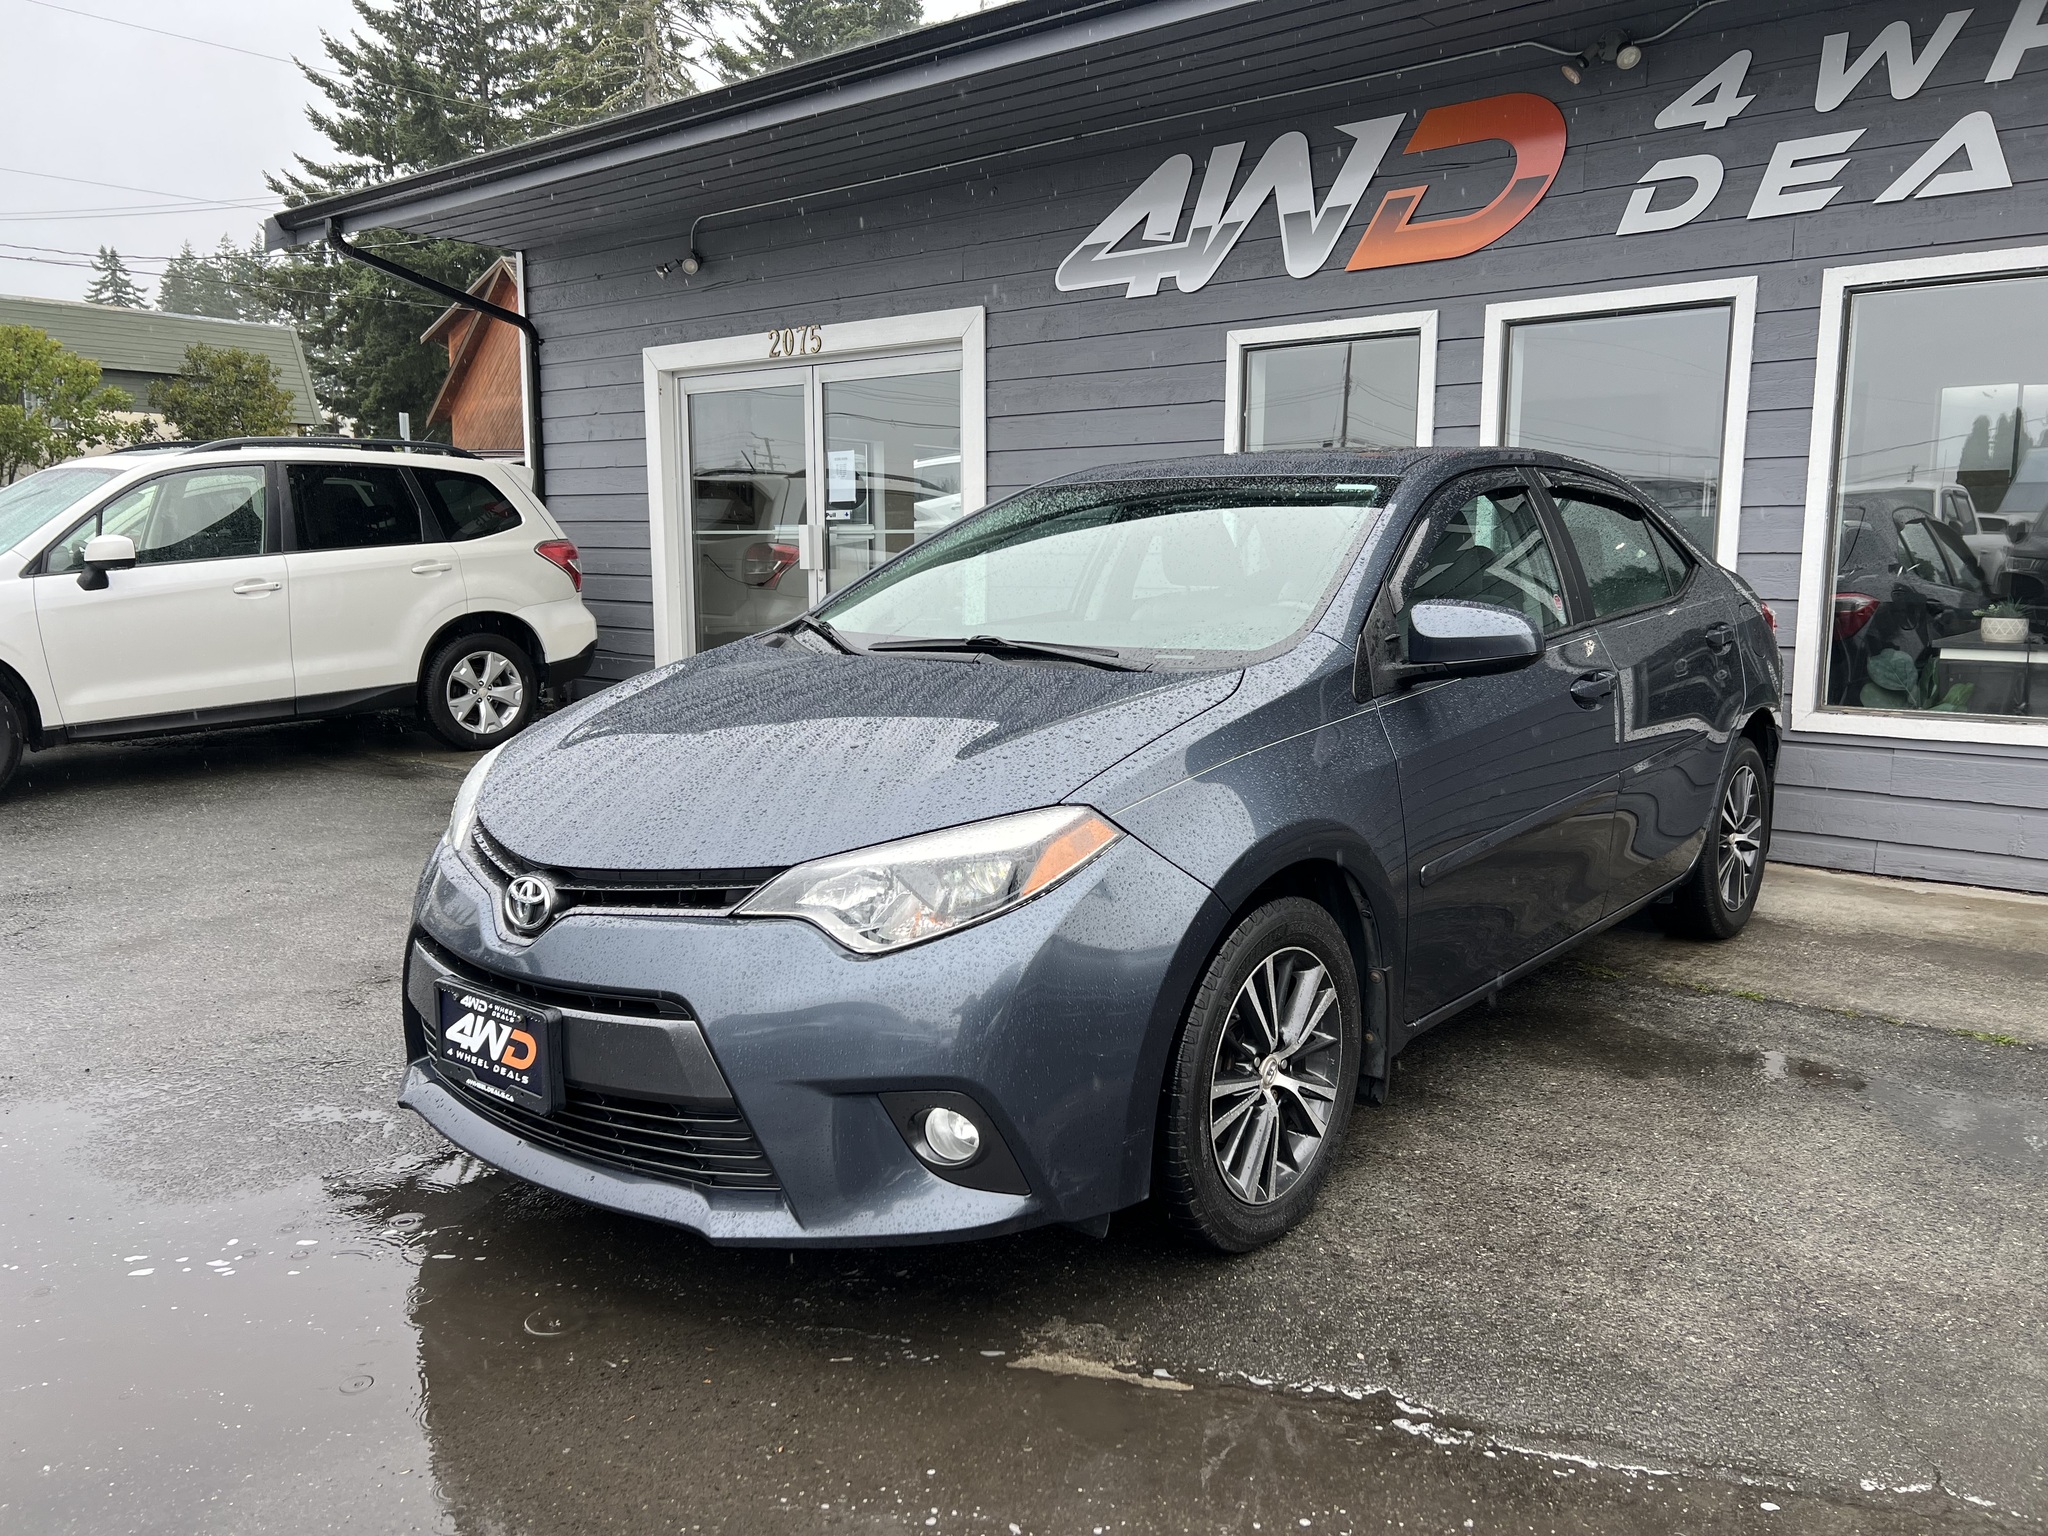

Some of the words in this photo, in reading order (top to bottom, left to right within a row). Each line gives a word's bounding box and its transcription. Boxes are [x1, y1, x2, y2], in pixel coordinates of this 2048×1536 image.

[1654, 49, 1757, 130] 4
[1616, 110, 2014, 236] DEA
[1054, 91, 1568, 299] 4WD
[768, 324, 822, 358] 2075
[460, 995, 487, 1012] 4WD
[491, 1010, 515, 1023] DEALS
[494, 1005, 516, 1017] WHEEL
[445, 1012, 537, 1070] 4WD
[447, 1048, 453, 1056] 4
[456, 1050, 489, 1069] WHEEL
[493, 1065, 529, 1084] DEALS
